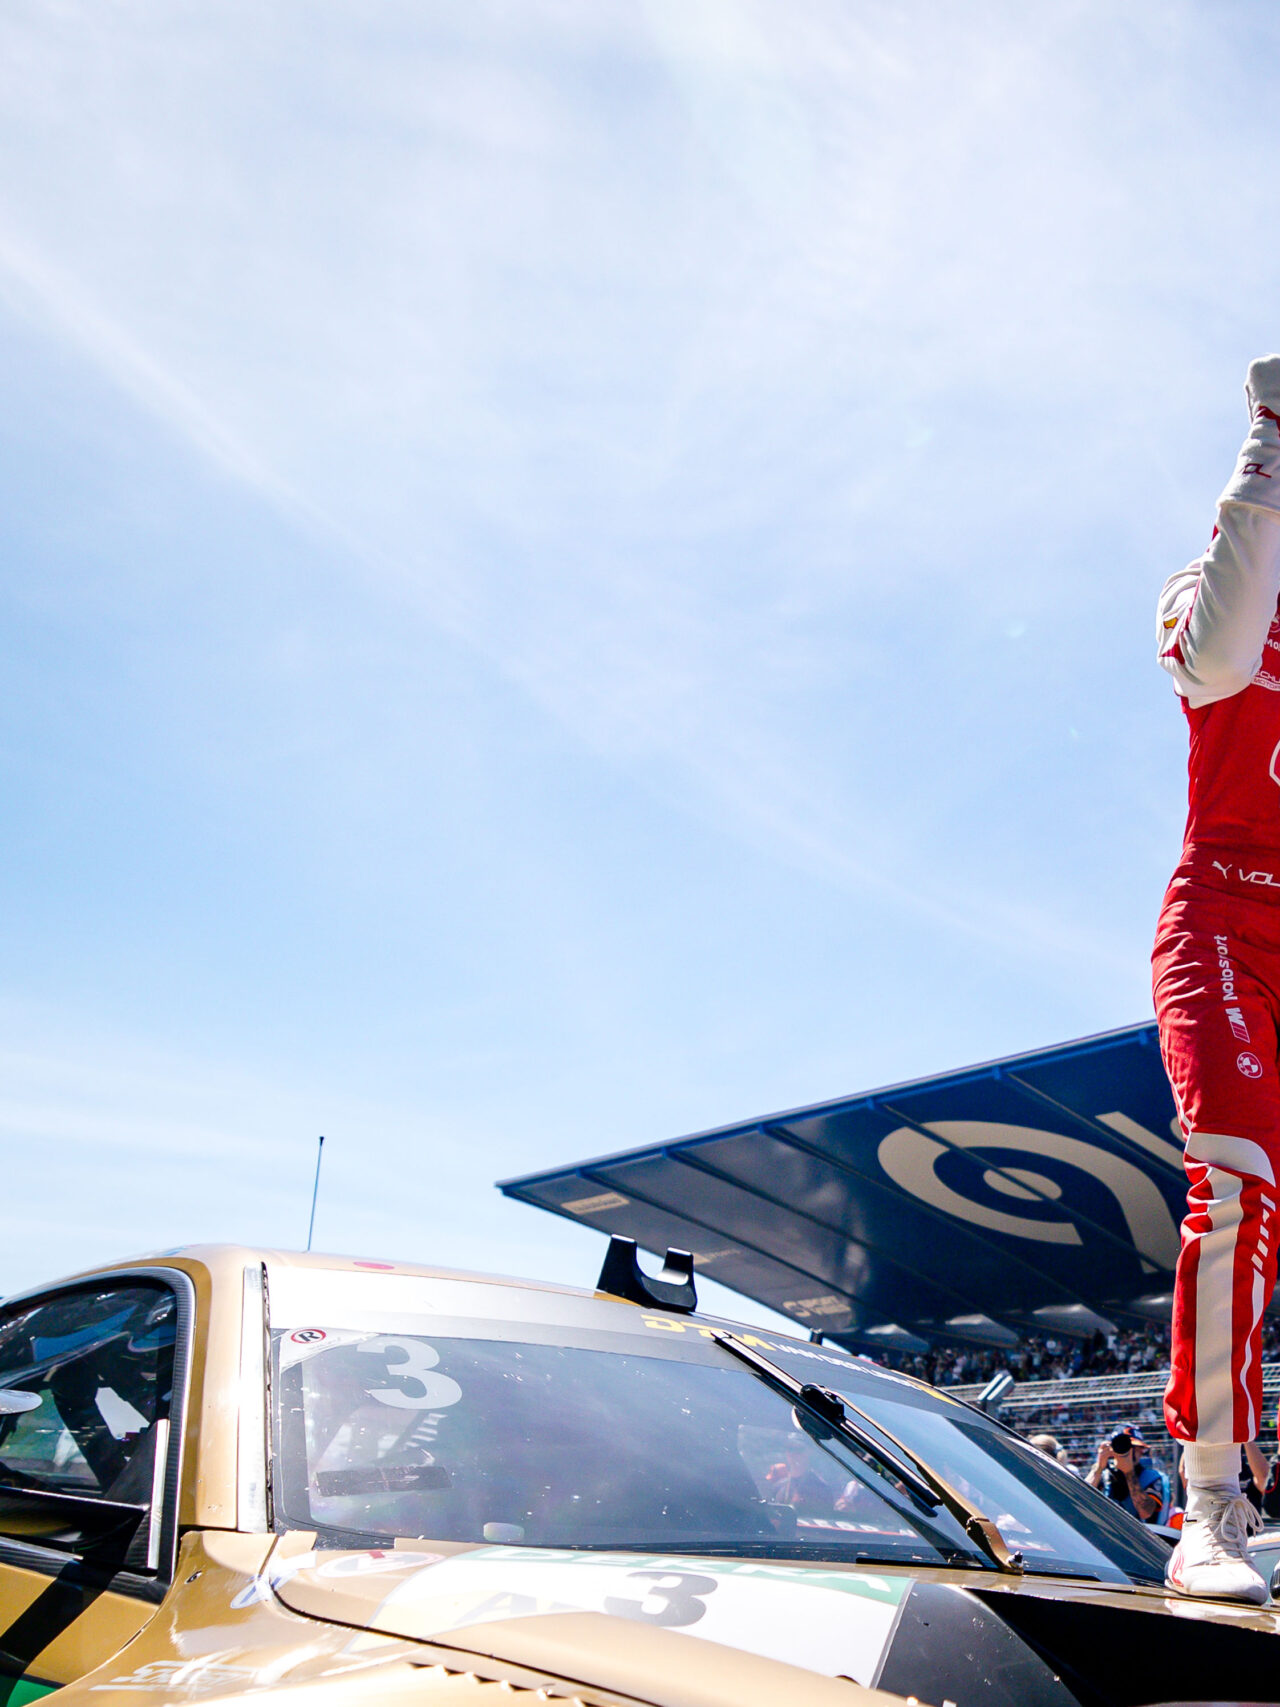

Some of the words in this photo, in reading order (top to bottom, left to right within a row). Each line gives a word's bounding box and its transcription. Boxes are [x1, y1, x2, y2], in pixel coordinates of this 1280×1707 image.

[356, 1336, 463, 1410] 3
[481, 1547, 892, 1593] DEKRA
[603, 1571, 719, 1628] 3
